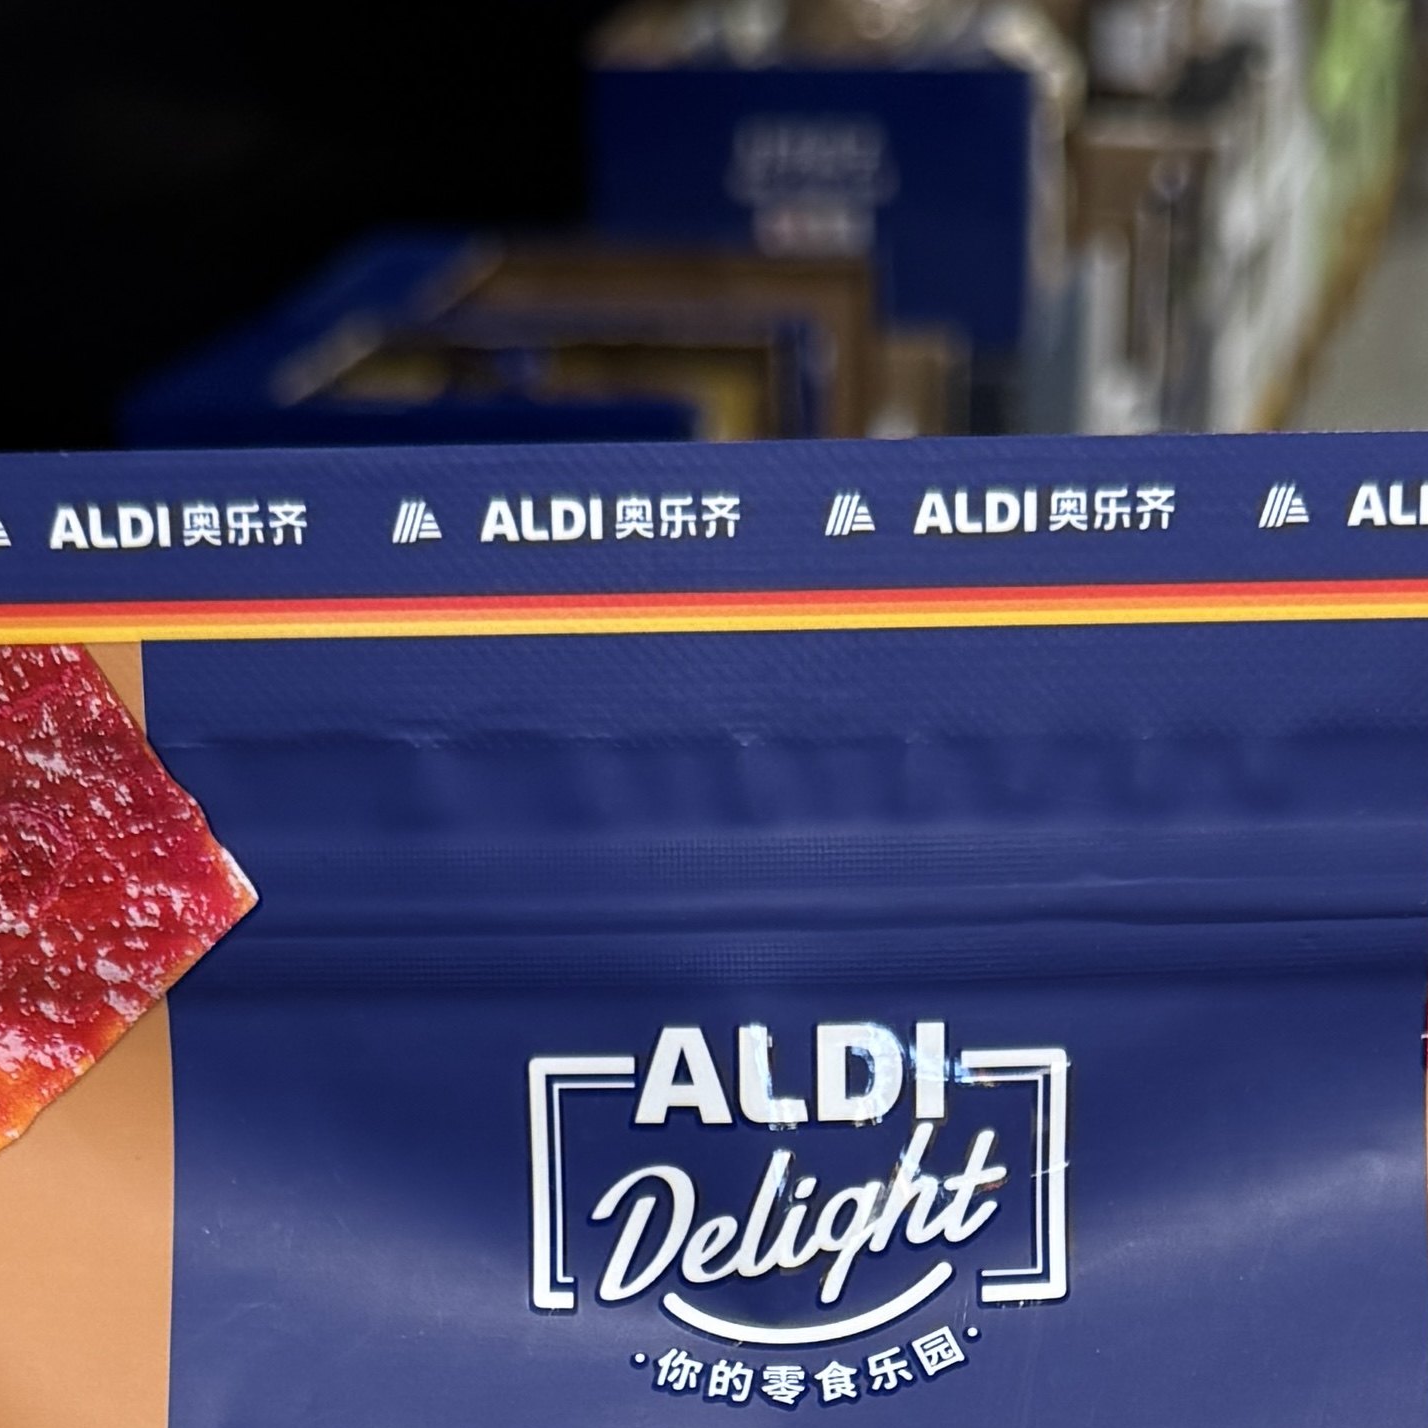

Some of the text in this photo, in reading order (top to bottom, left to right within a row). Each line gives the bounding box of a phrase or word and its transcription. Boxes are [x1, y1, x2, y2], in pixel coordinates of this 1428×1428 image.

[50, 503, 307, 549] ALDI 奥乐齐
[481, 496, 740, 541] ALDI 奥乐齐
[914, 487, 1174, 534] ALDI 奥乐齐
[635, 1022, 946, 1125] ALDI
[592, 1122, 1007, 1303] Delight
[657, 1326, 965, 1405] 你的零食乐园
